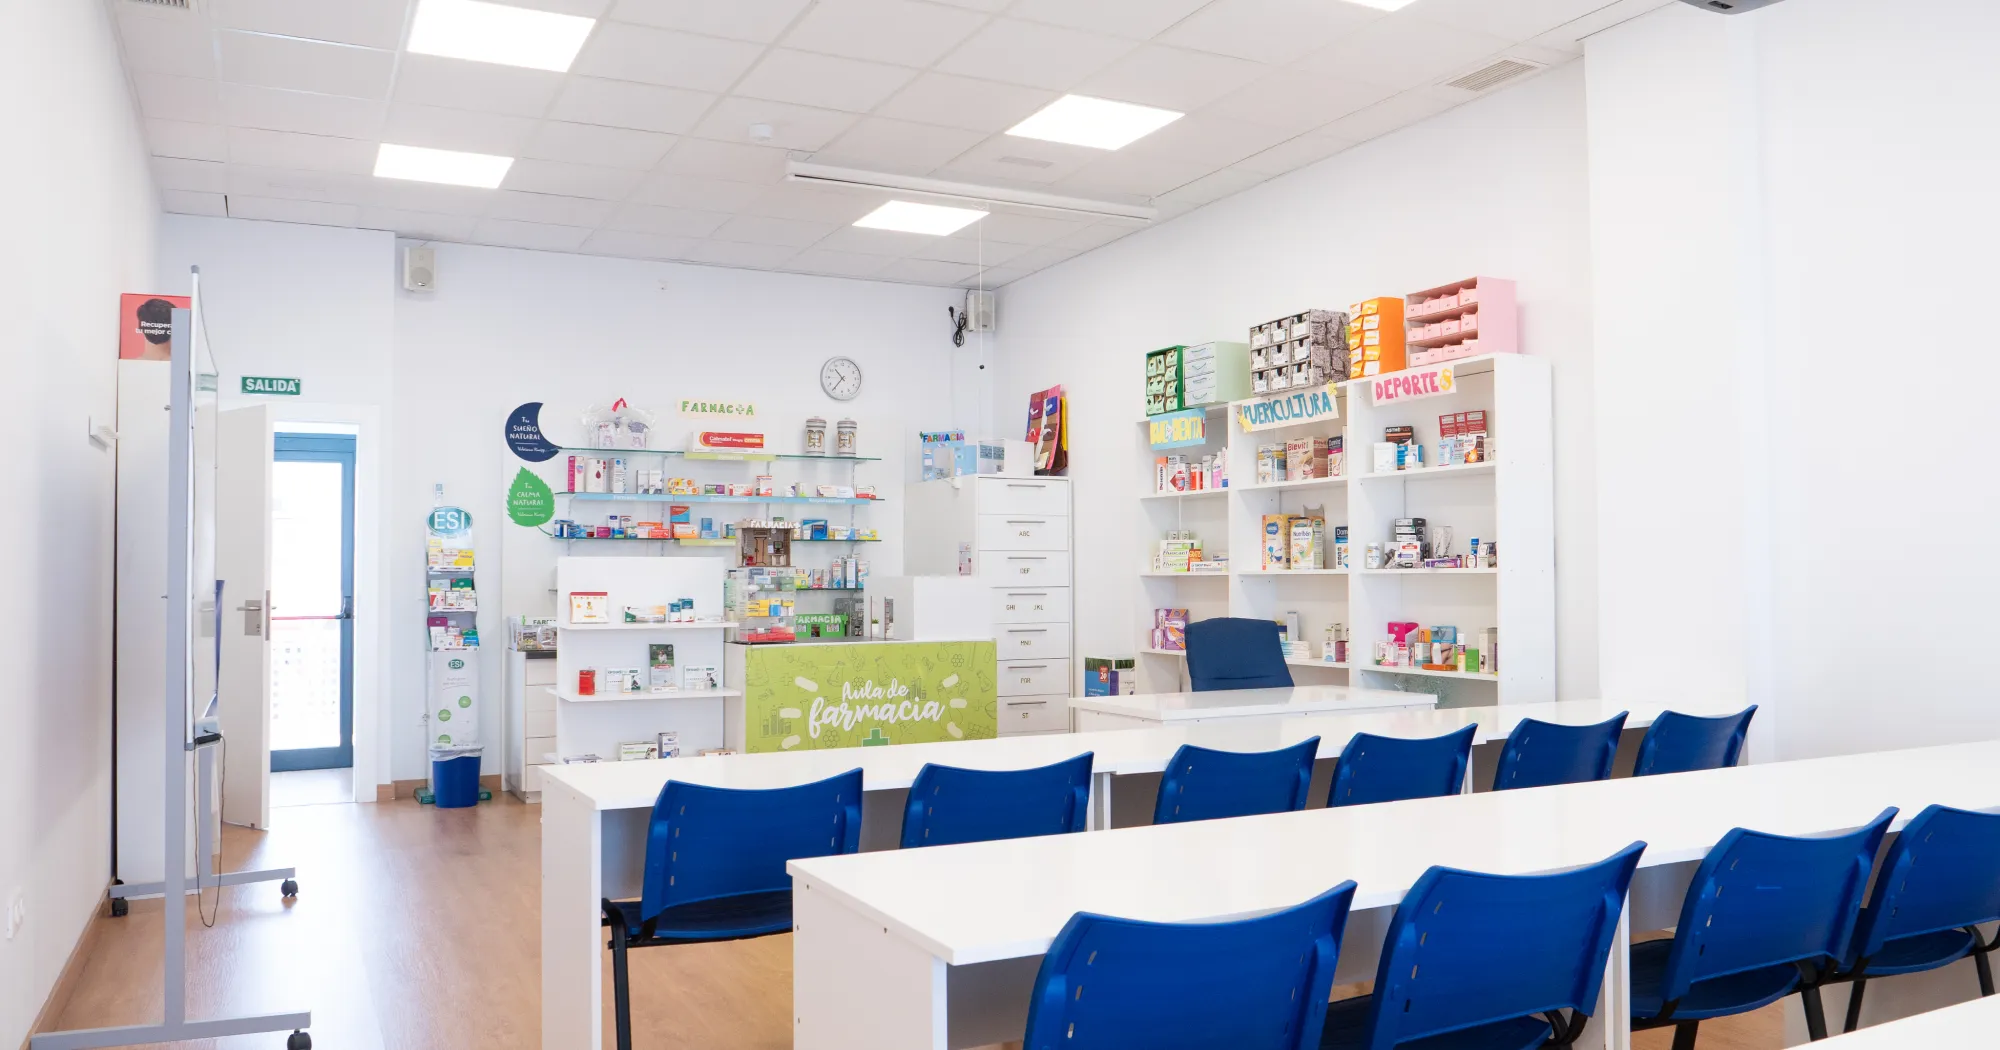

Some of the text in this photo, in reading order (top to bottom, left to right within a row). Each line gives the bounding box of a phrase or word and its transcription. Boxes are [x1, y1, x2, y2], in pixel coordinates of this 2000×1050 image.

[140, 321, 172, 329] Recuper
[245, 378, 297, 393] SALIDA
[1375, 371, 1439, 401] DEPORTE
[1243, 391, 1333, 425] PUERICULTURA
[513, 424, 538, 433] SUEÑO
[509, 433, 541, 441] NATURAL
[922, 432, 965, 443] FARMACIA
[1287, 442, 1307, 451] Blevit
[433, 511, 466, 530] ESI
[450, 660, 463, 668] ESI
[842, 678, 911, 702] Aula de
[808, 696, 945, 739] farmacia
